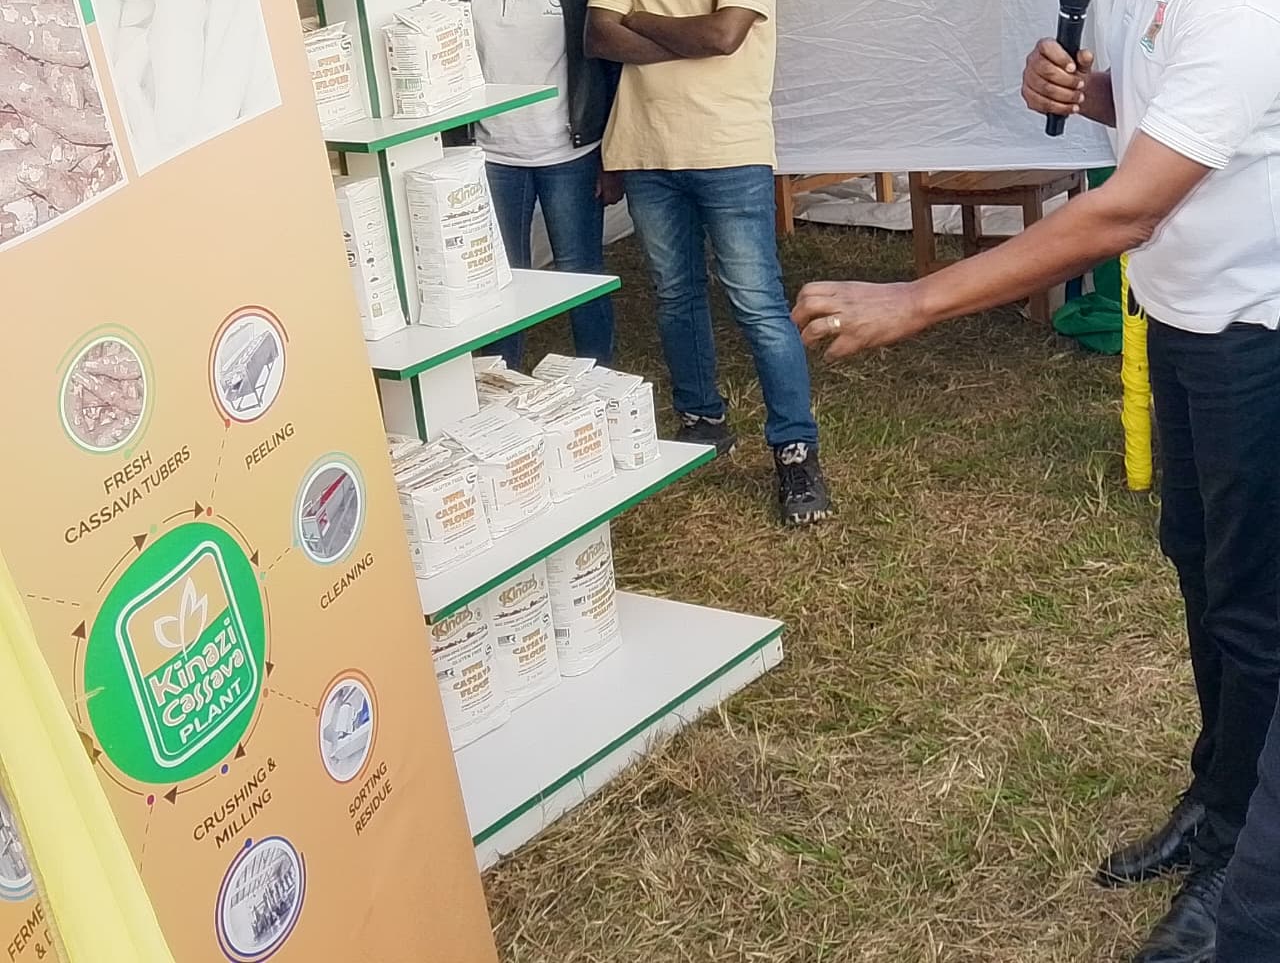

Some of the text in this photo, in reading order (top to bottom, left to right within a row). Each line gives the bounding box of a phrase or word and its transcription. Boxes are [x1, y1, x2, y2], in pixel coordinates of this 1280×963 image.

[103, 450, 153, 495] FRESH
[244, 422, 296, 470] PEELING
[64, 445, 192, 544] CASSAVA TUBERS
[319, 552, 375, 611] CLEANING
[148, 616, 238, 707] Kinazi
[180, 677, 241, 744] PLANT
[193, 757, 277, 841] CRUSHING &
[214, 788, 273, 849] MILLING
[348, 761, 388, 819] SORTING
[354, 779, 393, 837] RESIDUE
[7, 902, 44, 963] FERME
[34, 942, 47, 960] &
